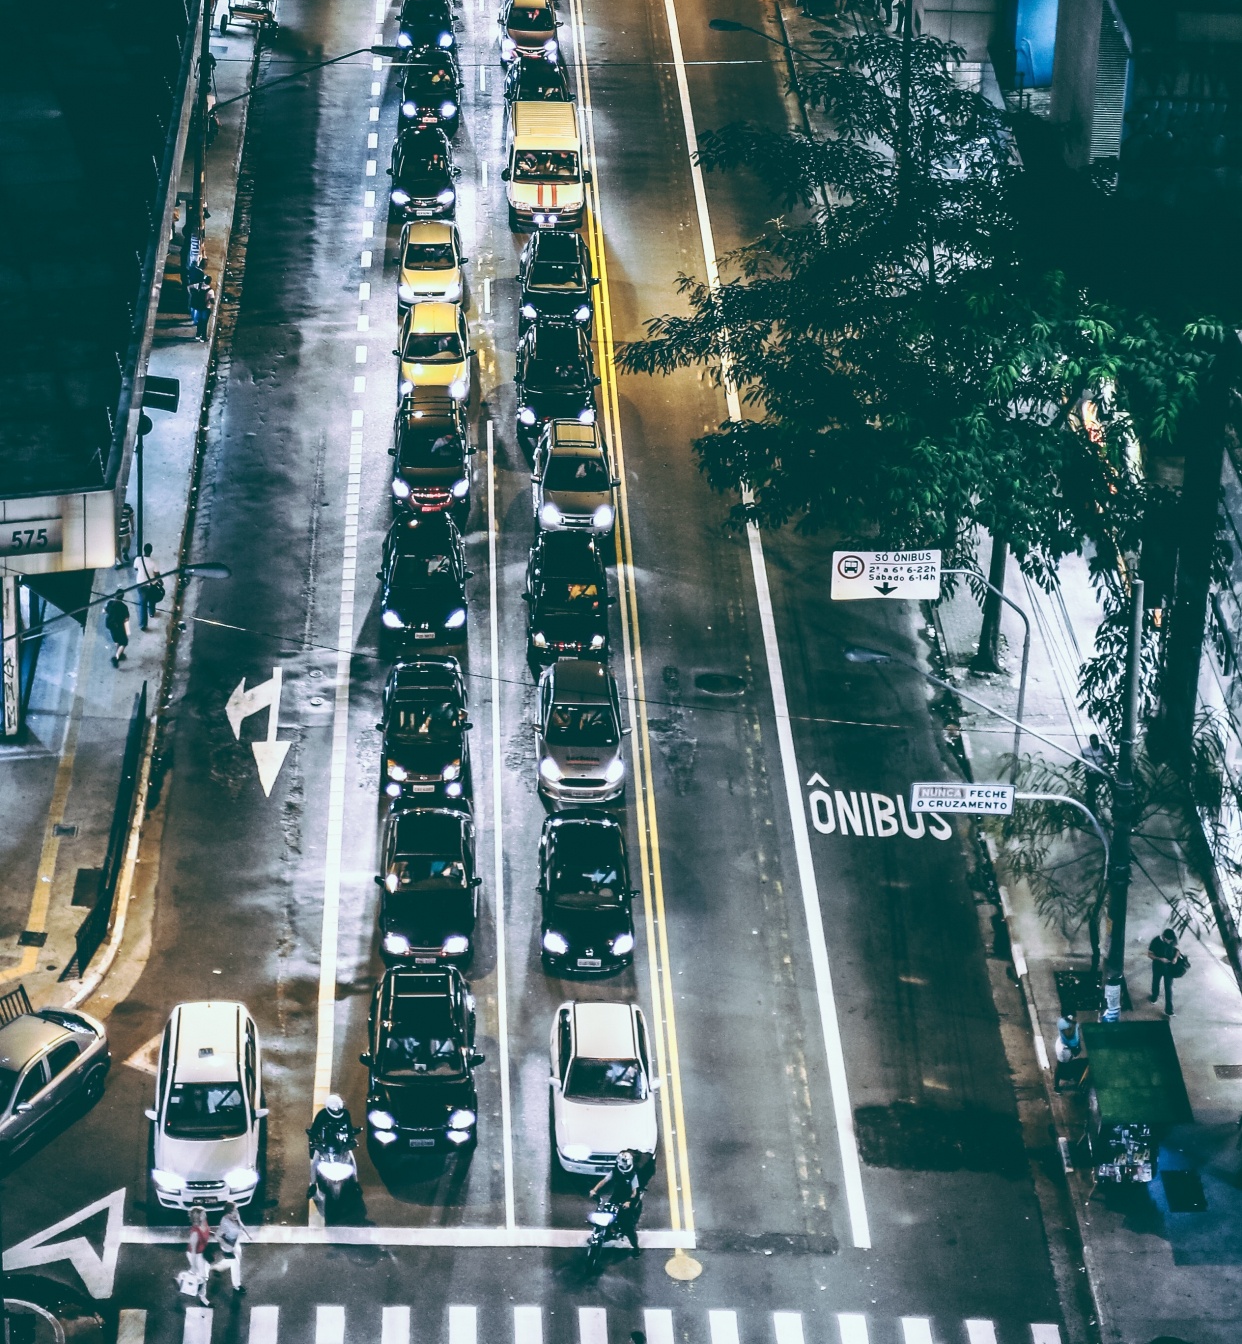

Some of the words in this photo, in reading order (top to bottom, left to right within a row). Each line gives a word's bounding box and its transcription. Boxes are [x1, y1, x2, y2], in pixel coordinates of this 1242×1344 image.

[11, 528, 48, 551] 575
[875, 552, 889, 562] SÓ
[894, 552, 931, 562] ÔNIBUS
[907, 566, 936, 574] 6-22h
[869, 573, 905, 582] Sábado
[909, 574, 936, 582] 6-14h
[921, 787, 963, 797] NUNCA
[970, 790, 1007, 799] FECHE
[917, 800, 924, 808] O
[928, 800, 1007, 810] CRUZAMENTO
